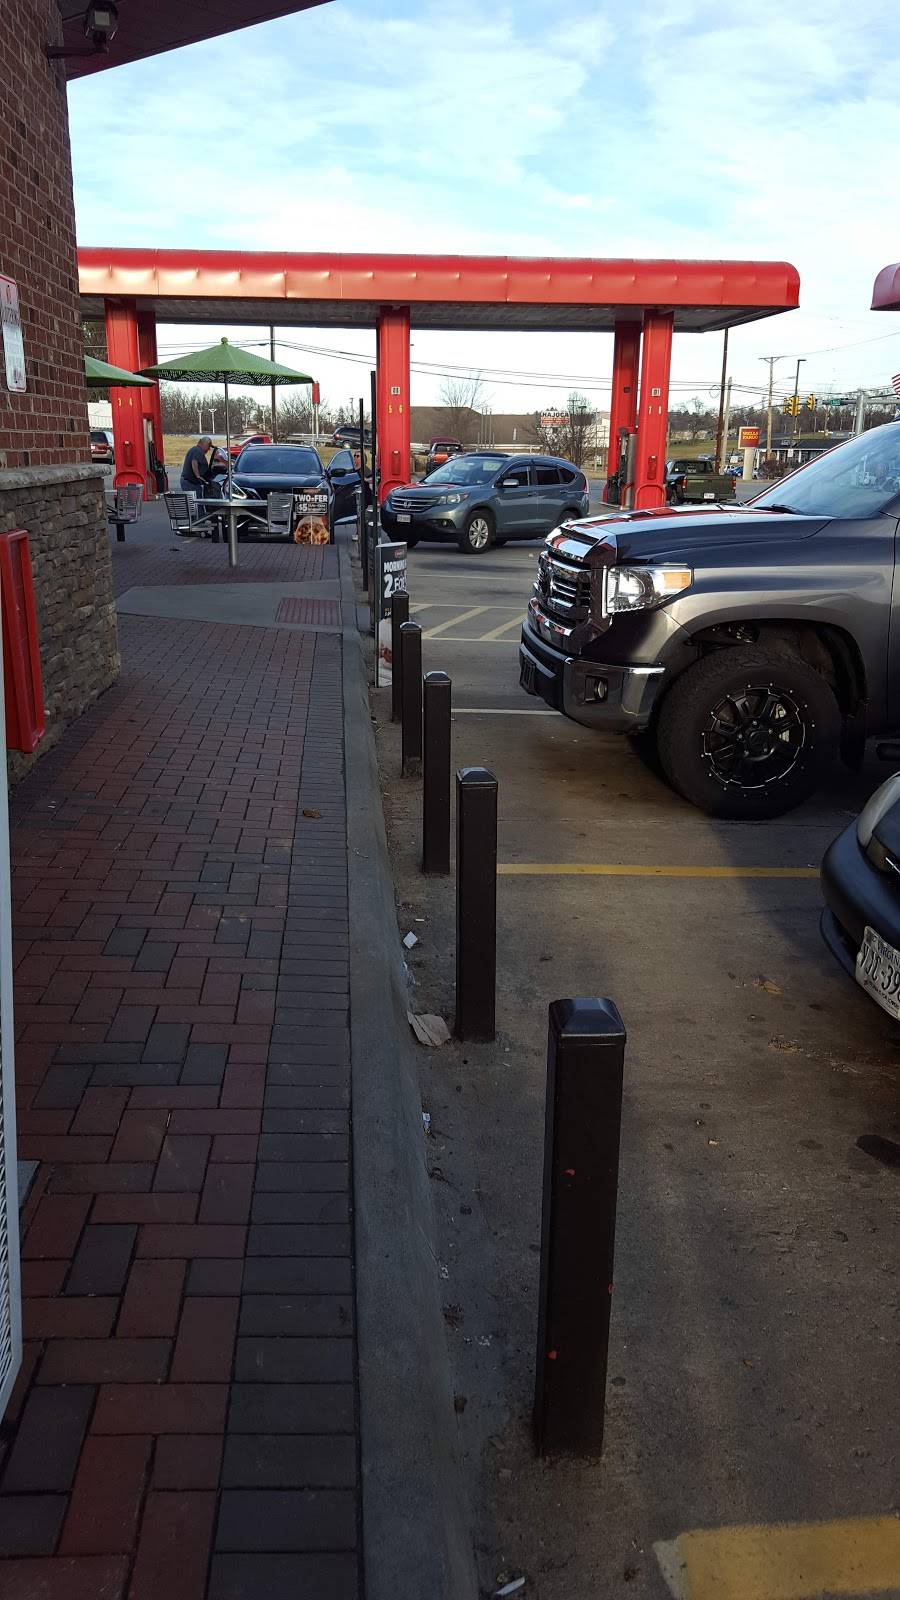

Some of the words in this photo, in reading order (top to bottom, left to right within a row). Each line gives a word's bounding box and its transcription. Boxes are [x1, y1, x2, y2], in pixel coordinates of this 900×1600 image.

[294, 494, 328, 502] TWO-FER
[298, 503, 308, 512] $5
[384, 573, 394, 598] 2
